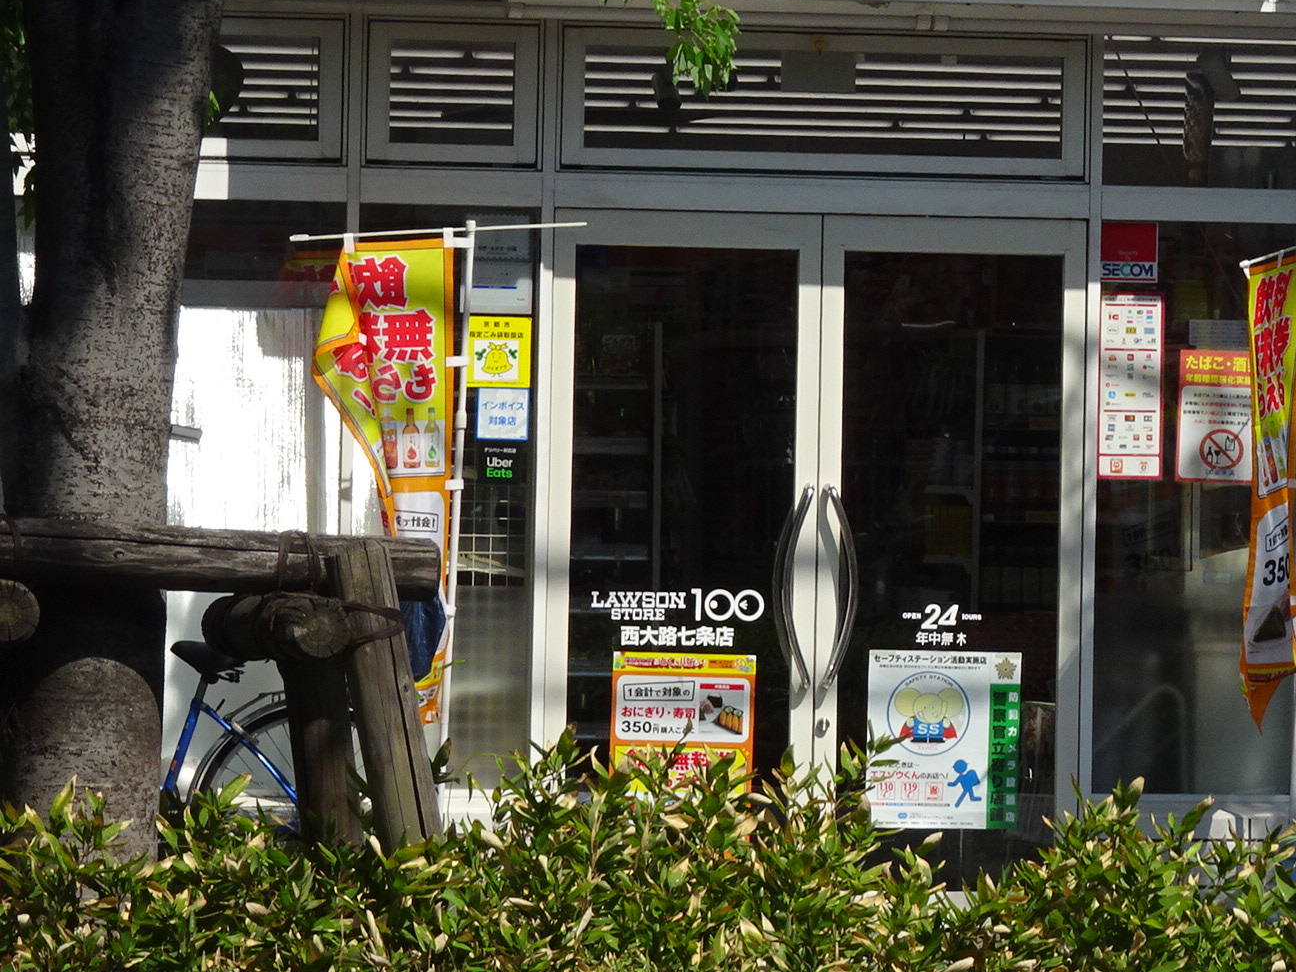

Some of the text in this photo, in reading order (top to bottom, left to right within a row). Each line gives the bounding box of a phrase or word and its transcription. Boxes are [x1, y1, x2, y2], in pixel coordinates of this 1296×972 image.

[1102, 263, 1153, 277] SECOM
[1185, 355, 1251, 373] たばこ・酒
[481, 401, 525, 411] インボイス
[488, 416, 517, 426] 対象店
[486, 456, 513, 467] Uber
[486, 468, 513, 478] Eats
[591, 591, 686, 609] LAWSON
[691, 588, 765, 622] 100
[611, 608, 666, 621] STORE
[921, 603, 960, 630] 24
[620, 625, 735, 647] 西大路七条店
[904, 674, 954, 688] SAFETY STATION
[627, 686, 691, 697] 1会計で対象の
[621, 706, 696, 719] おにぎり・寿司
[917, 723, 940, 735] SS
[879, 782, 918, 791] 110 119
